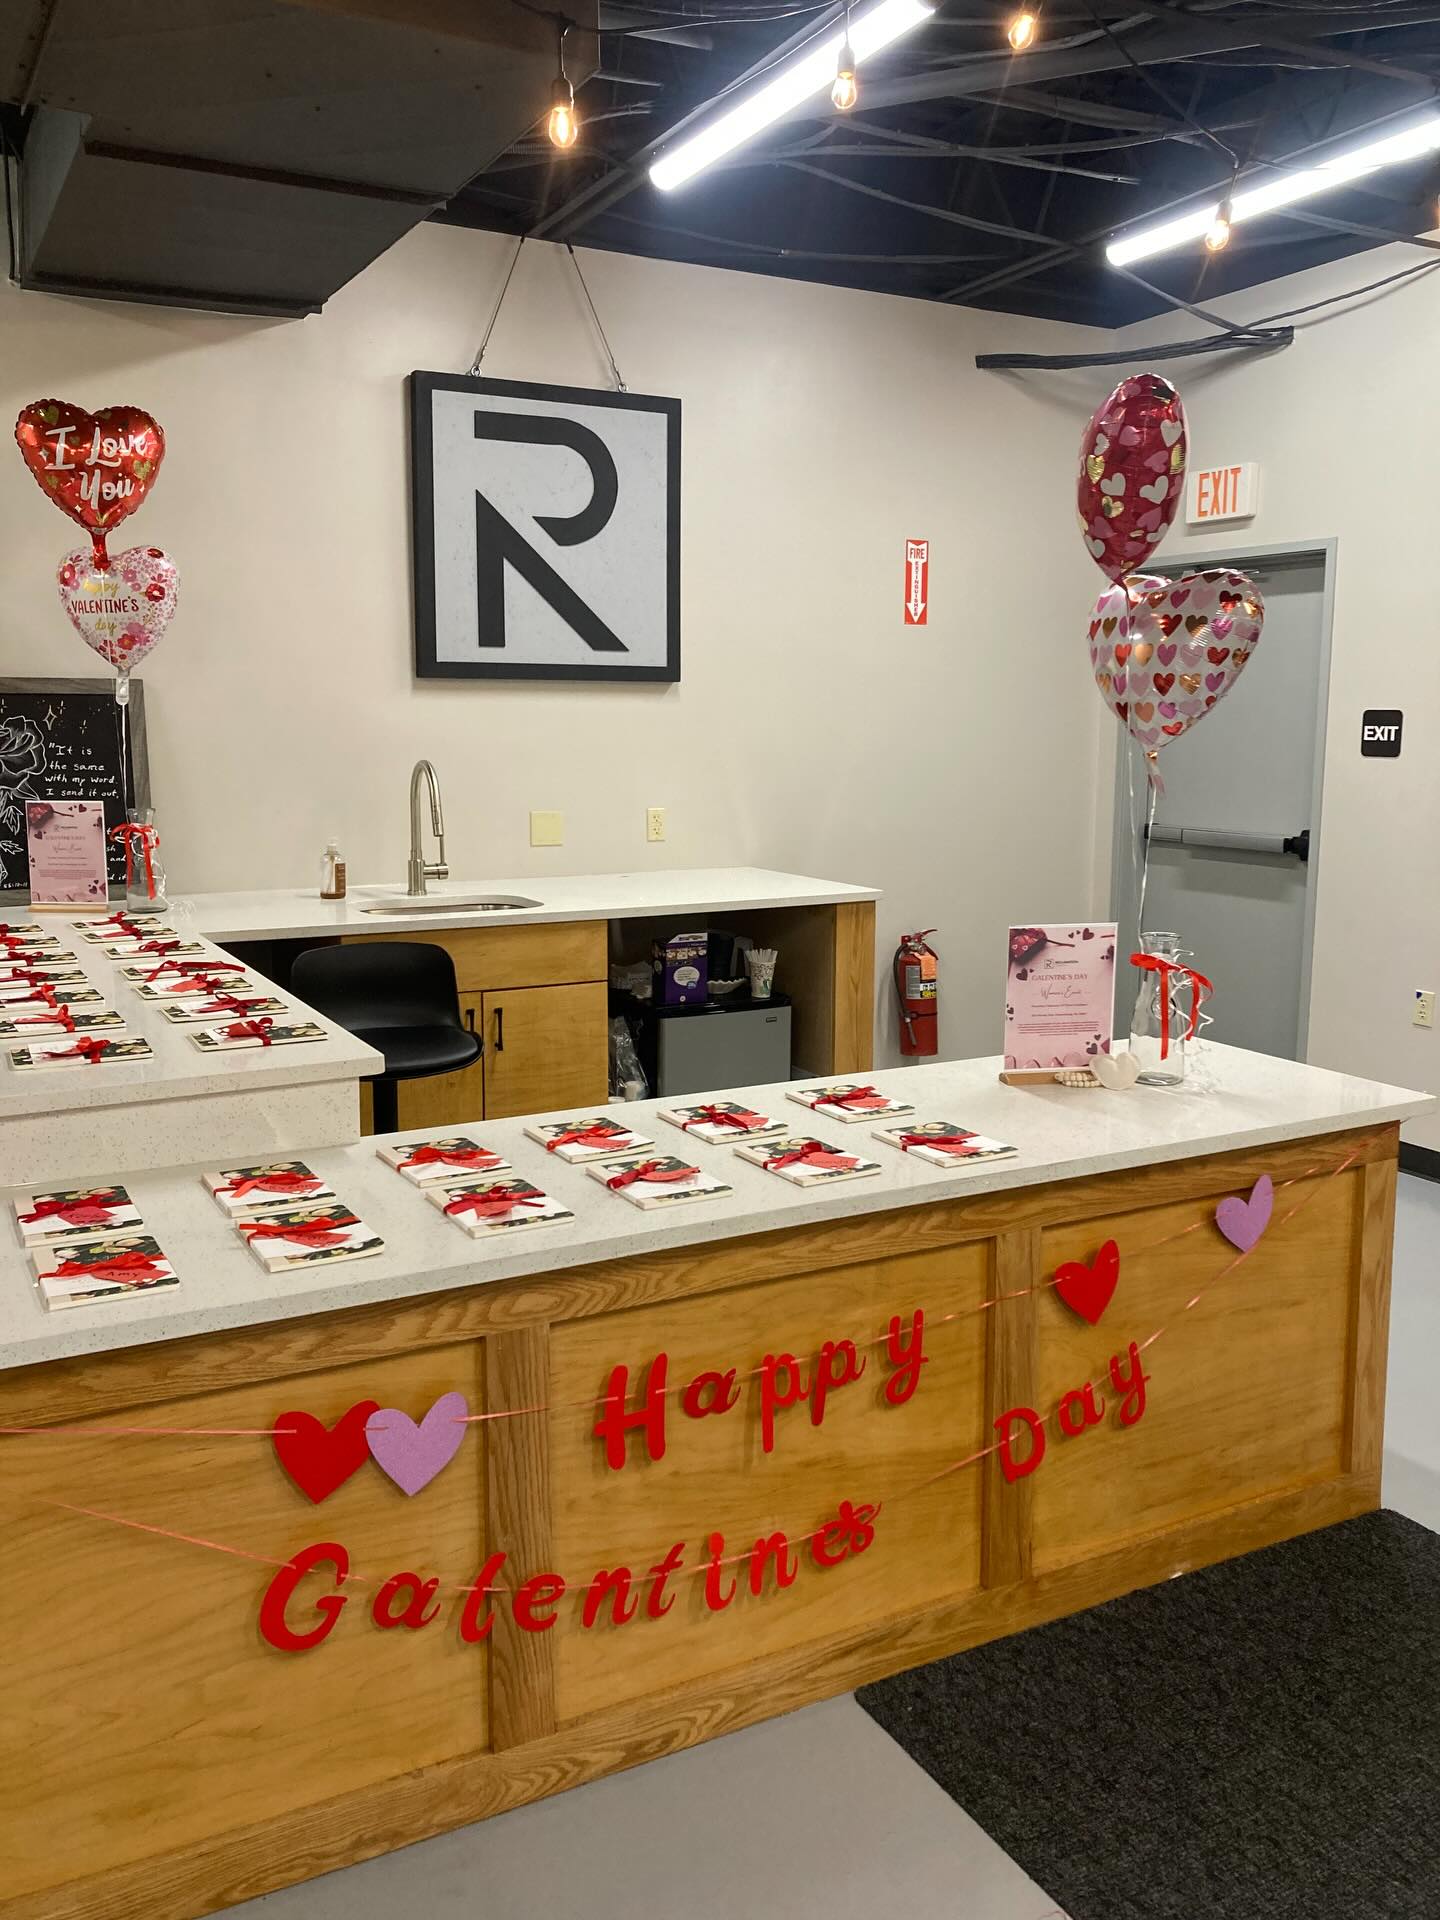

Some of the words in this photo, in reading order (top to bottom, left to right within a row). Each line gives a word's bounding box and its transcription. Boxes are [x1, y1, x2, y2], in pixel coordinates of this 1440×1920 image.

[44, 425, 76, 470] I
[85, 427, 147, 467] Love
[79, 469, 135, 510] You
[1198, 467, 1241, 517] EXIT
[474, 410, 629, 652] R
[910, 547, 925, 559] FIRE
[71, 596, 139, 614] VALENTINE'S
[95, 618, 117, 636] day
[1364, 726, 1399, 741] EXIT
[82, 746, 92, 755] is
[49, 761, 67, 770] the
[45, 774, 67, 783] with
[72, 777, 85, 786] my
[46, 788, 54, 796] I
[61, 788, 83, 797] send
[89, 788, 97, 797] it
[593, 1309, 929, 1471] Happy
[993, 1341, 1151, 1483] Day
